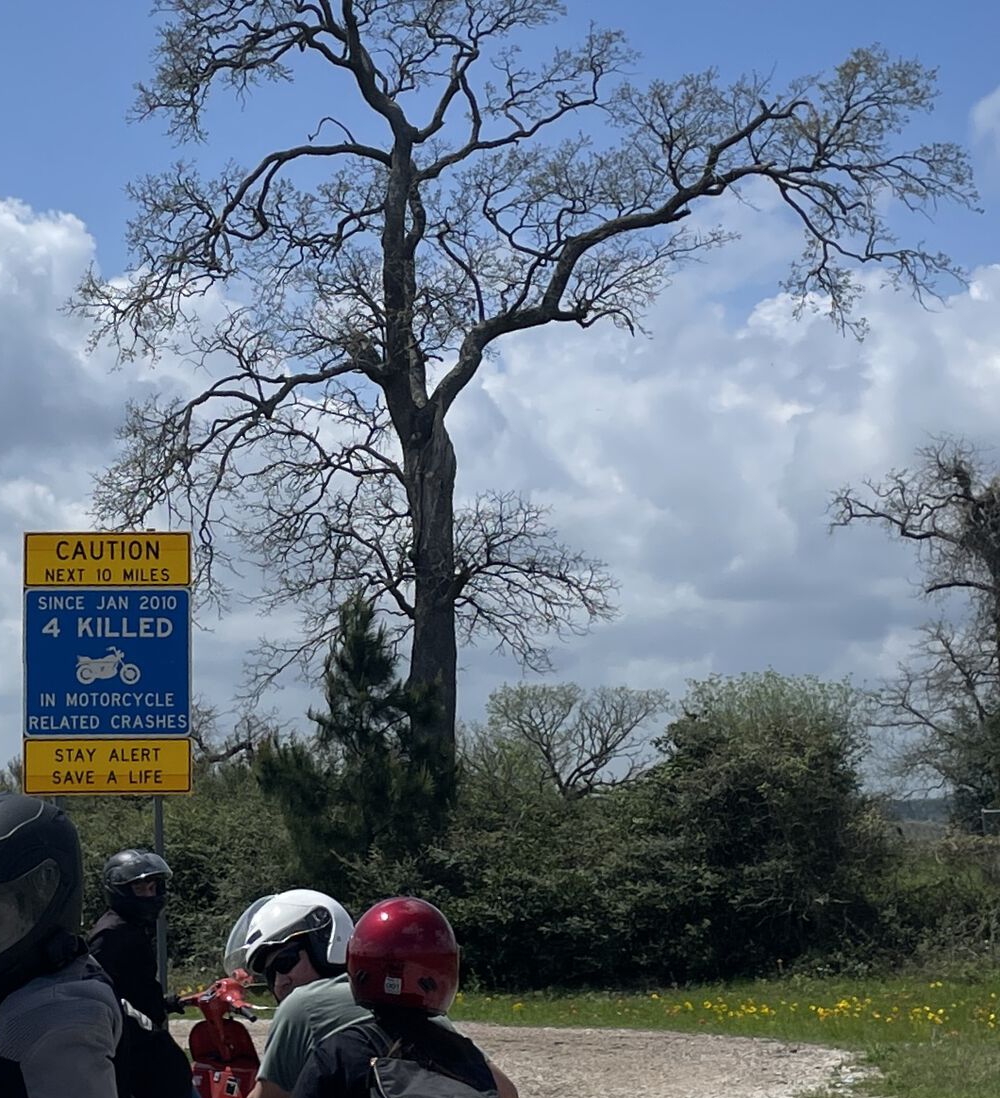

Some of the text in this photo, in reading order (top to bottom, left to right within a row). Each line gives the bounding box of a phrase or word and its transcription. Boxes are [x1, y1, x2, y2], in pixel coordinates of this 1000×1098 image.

[56, 540, 160, 561] CAUTION
[45, 568, 170, 582] NEXT 10 MILES
[38, 596, 177, 610] SINCE JAN 2010
[41, 617, 173, 638] 4 KILLED
[40, 693, 175, 707] IN MOTORCYCLE
[28, 714, 188, 730] RELATED CRASHES
[54, 748, 161, 762] STAY ALERT
[52, 771, 163, 785] SAVE A LIFE
